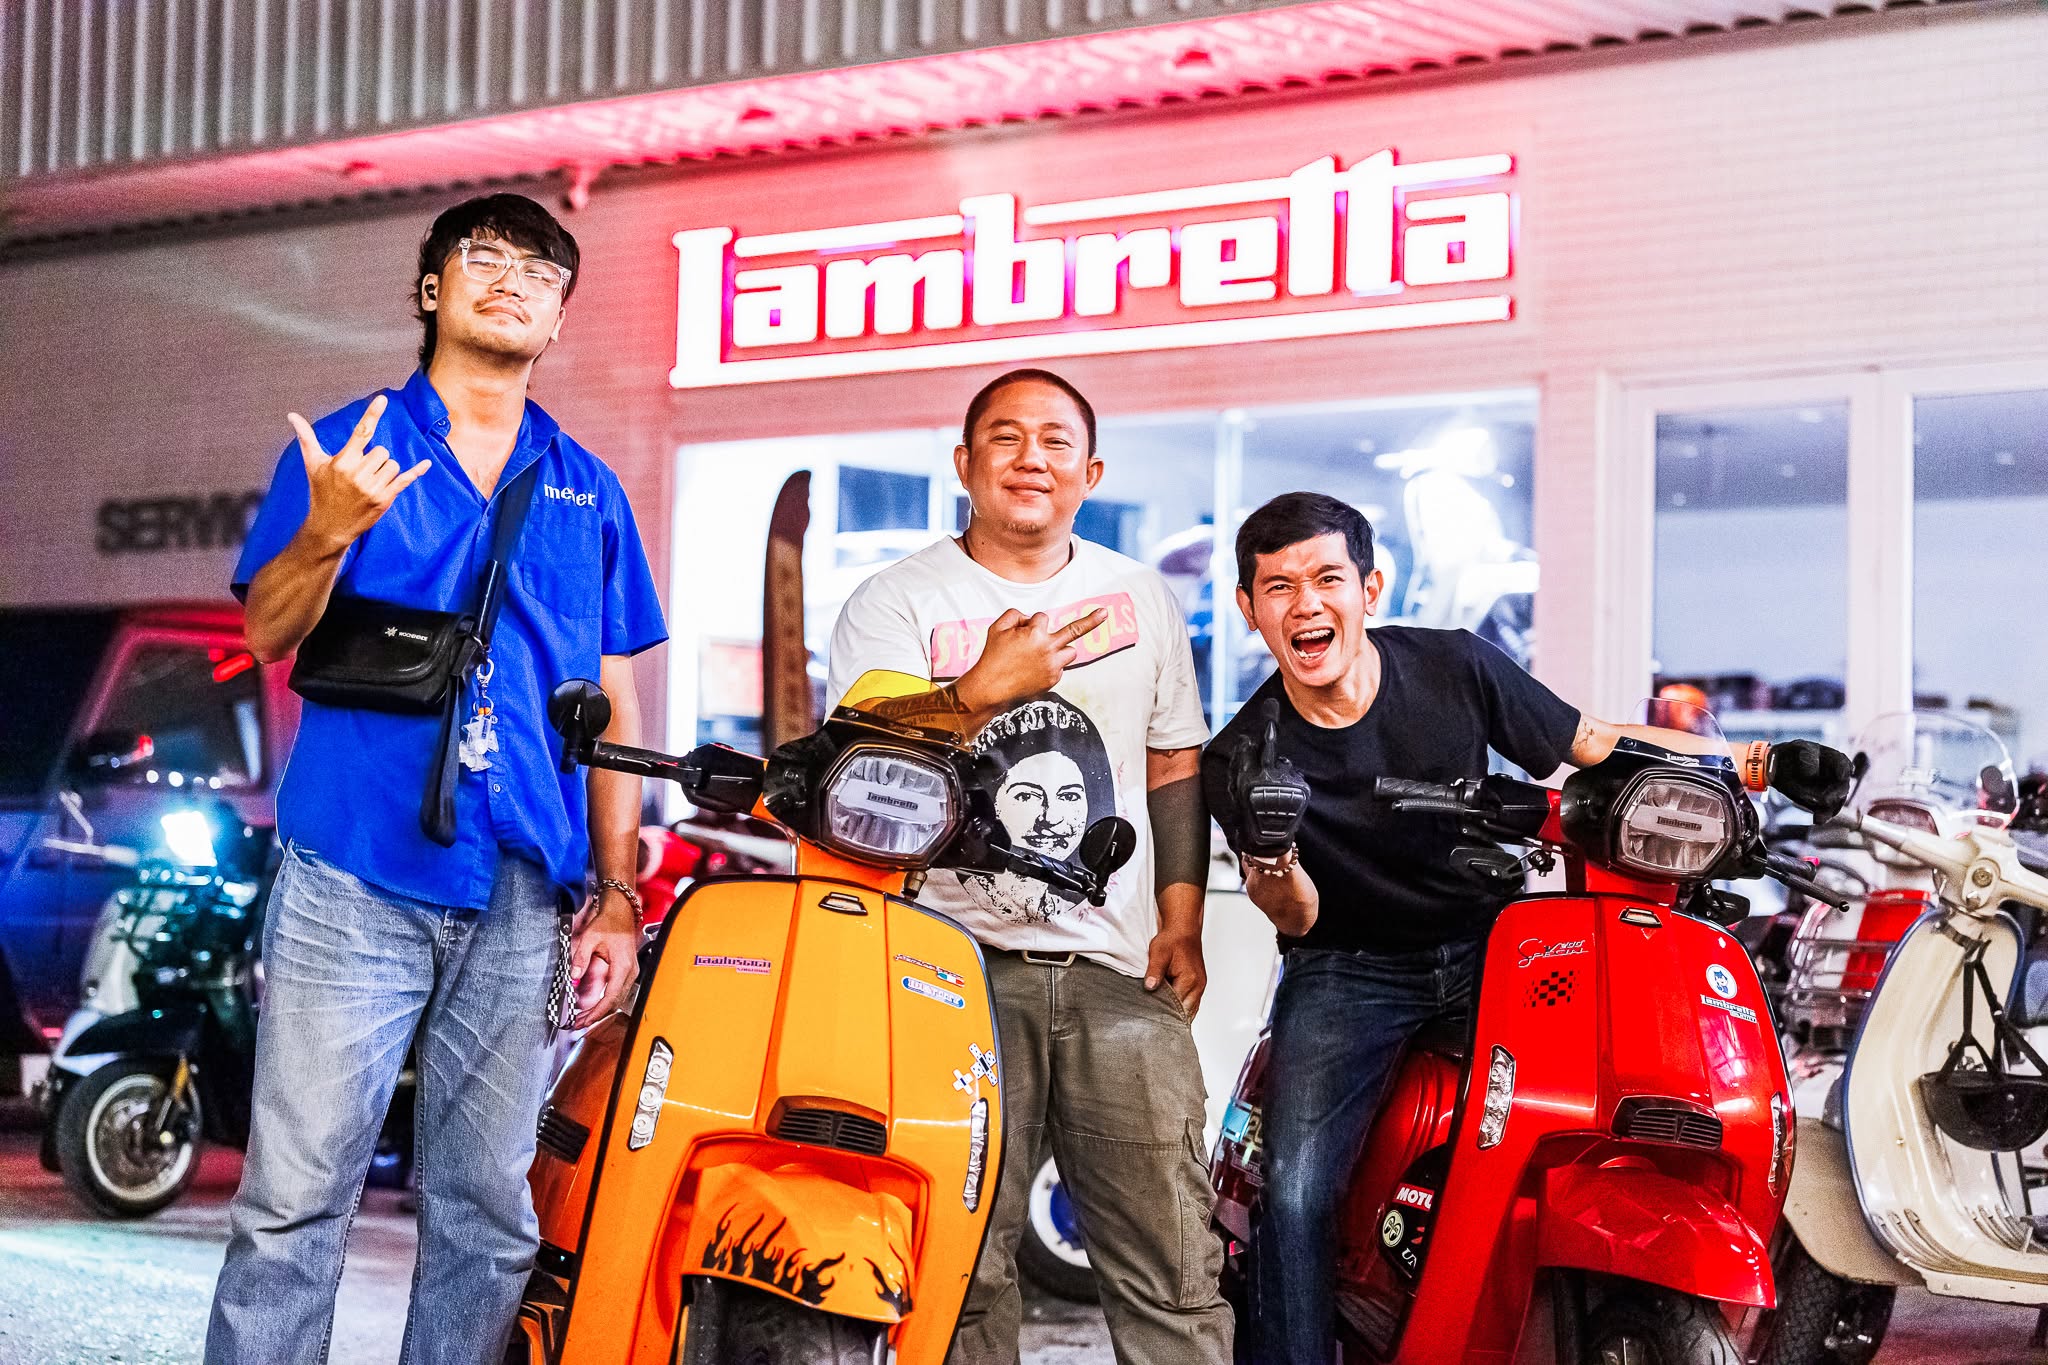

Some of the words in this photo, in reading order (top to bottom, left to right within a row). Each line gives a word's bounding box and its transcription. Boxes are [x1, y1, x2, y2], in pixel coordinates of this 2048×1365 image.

[668, 147, 1515, 389] Lambretta
[544, 484, 596, 507] meier
[866, 791, 919, 812] Lambretta
[1657, 815, 1703, 832] Lambretta
